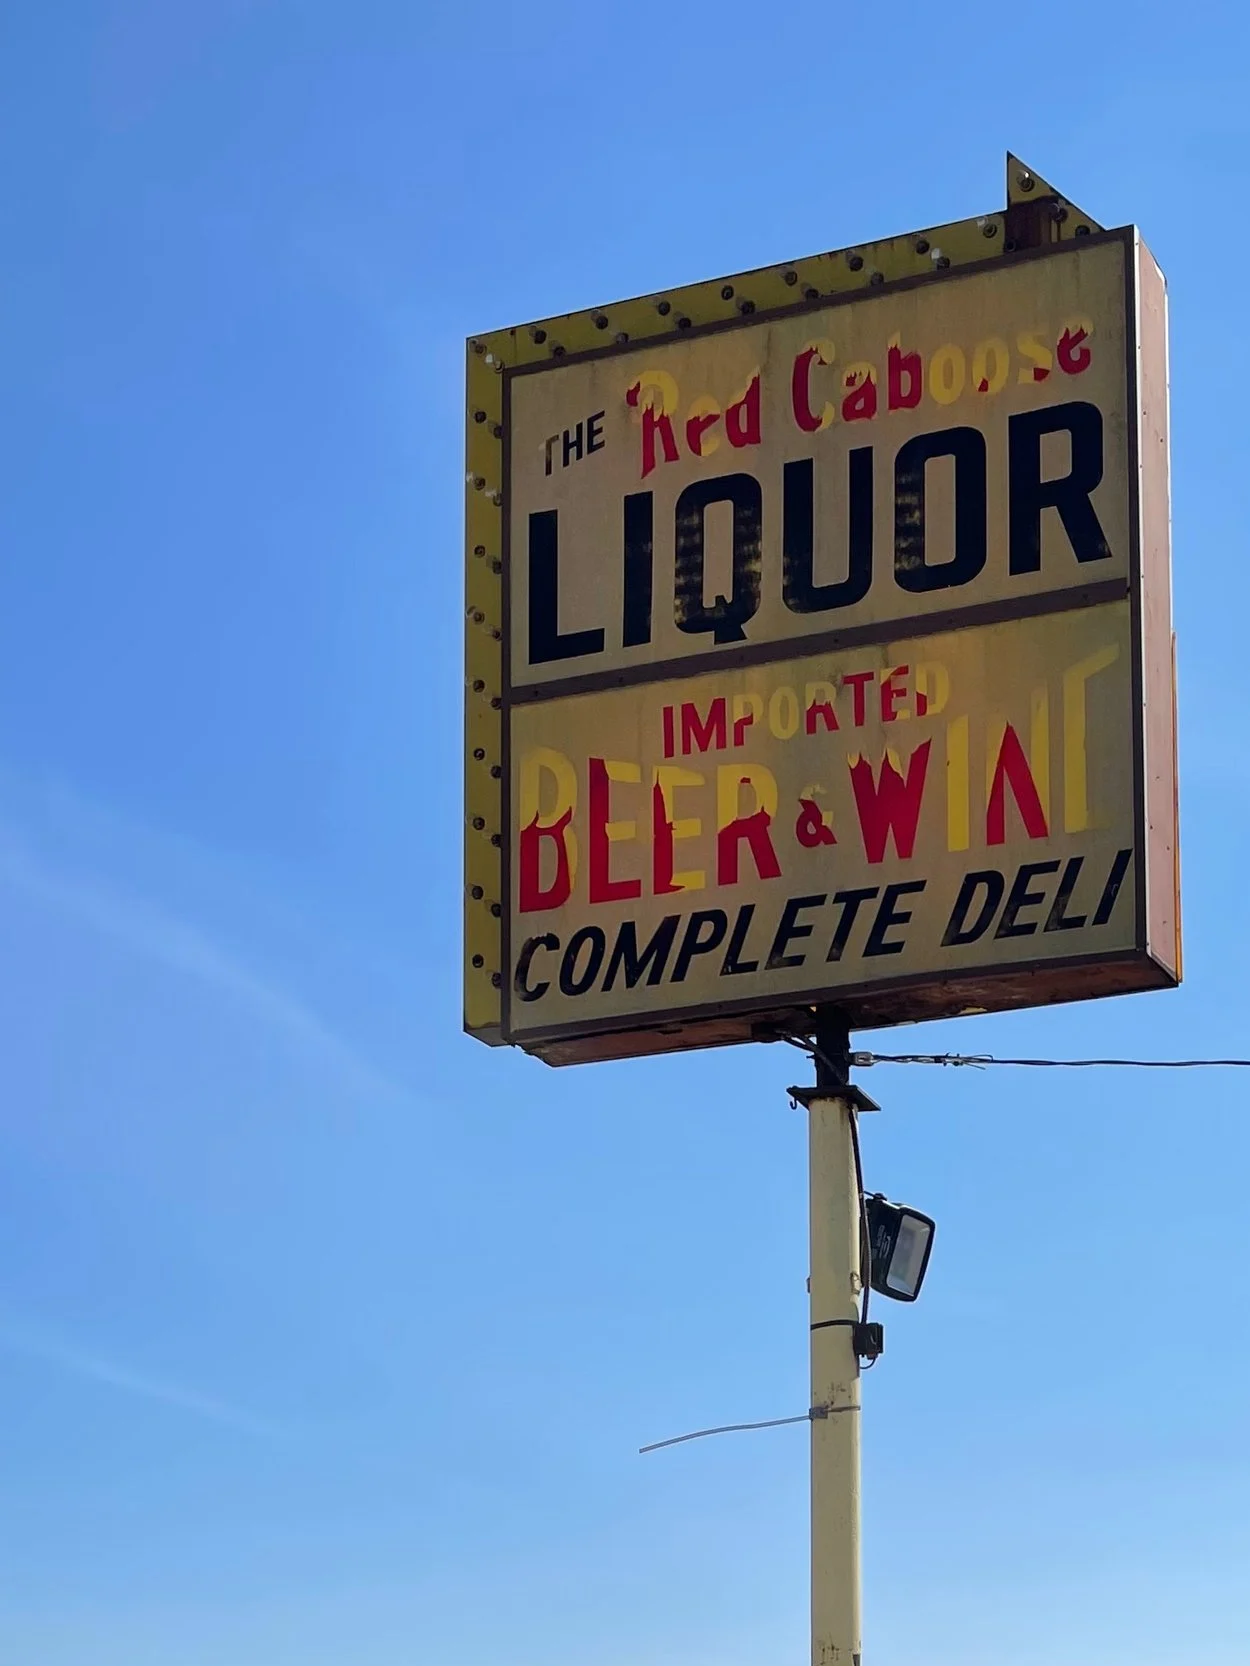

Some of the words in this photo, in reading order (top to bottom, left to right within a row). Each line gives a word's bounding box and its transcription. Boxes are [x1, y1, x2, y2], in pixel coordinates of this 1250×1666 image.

[540, 410, 605, 477] THE
[626, 369, 762, 479] Red
[791, 317, 1095, 433] Caboose
[528, 401, 1112, 666] LIQUOR
[662, 661, 949, 758] IMPORTED
[519, 747, 782, 913] BEER
[795, 783, 838, 848] &
[514, 880, 926, 1001] COMPLETE
[940, 849, 1133, 947] DELI
